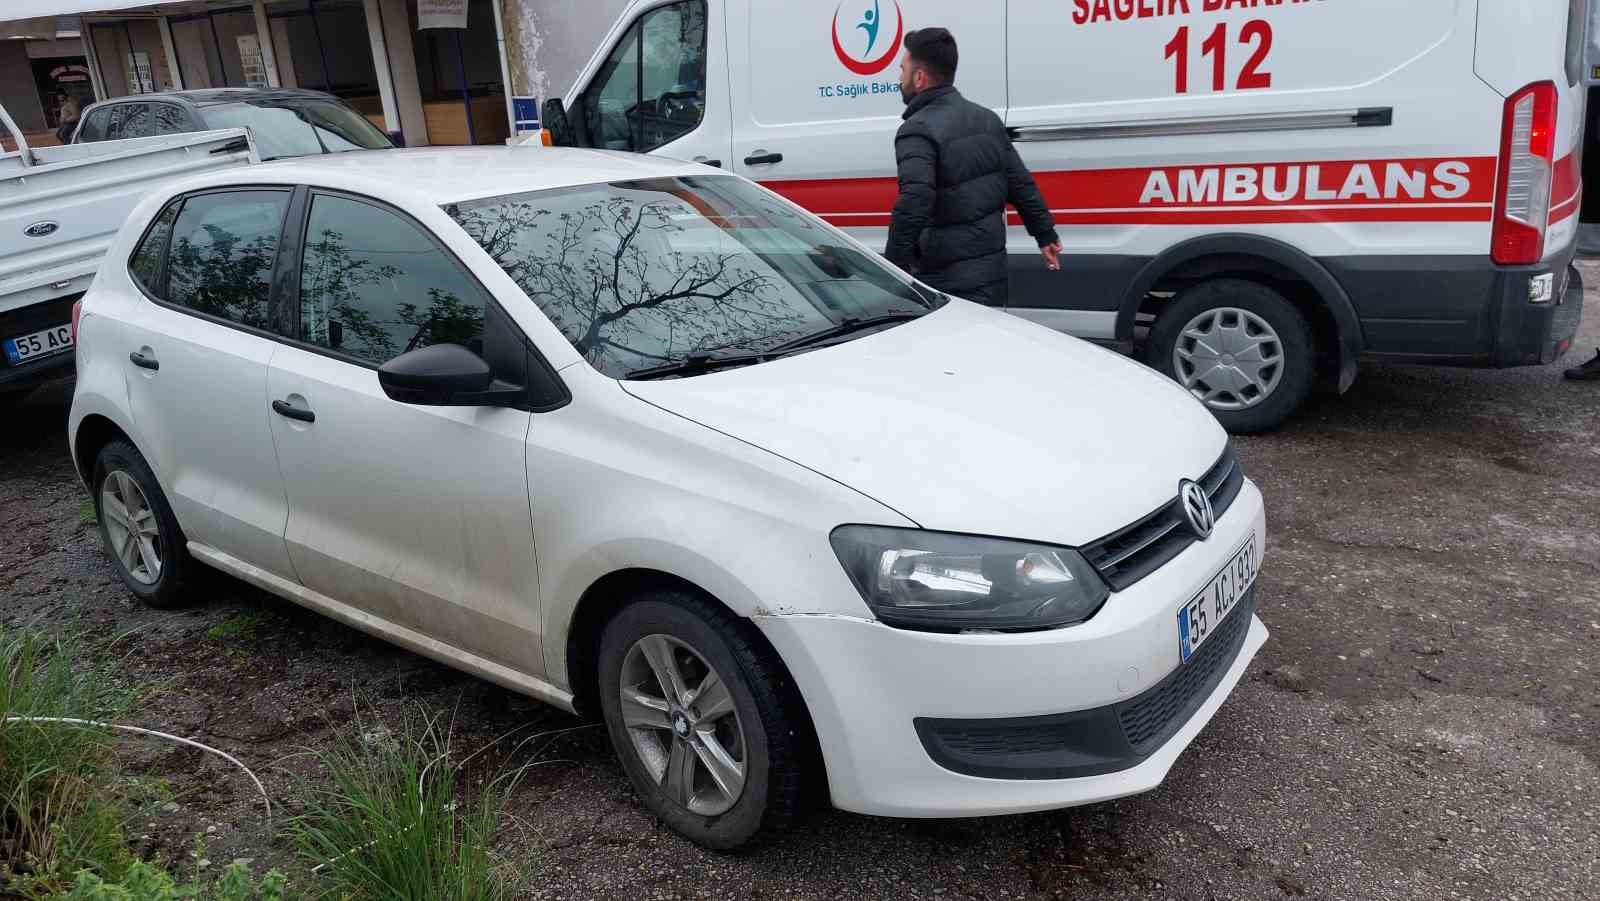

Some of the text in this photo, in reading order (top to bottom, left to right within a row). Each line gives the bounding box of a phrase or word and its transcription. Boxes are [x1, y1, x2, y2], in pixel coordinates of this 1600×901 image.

[1165, 19, 1272, 93] 112
[836, 85, 868, 98] Sağlık
[871, 82, 900, 94] Baka
[1138, 160, 1471, 203] AMBULANS
[16, 328, 73, 355] 55 AC
[1190, 543, 1256, 644] 55 ACJ 932
